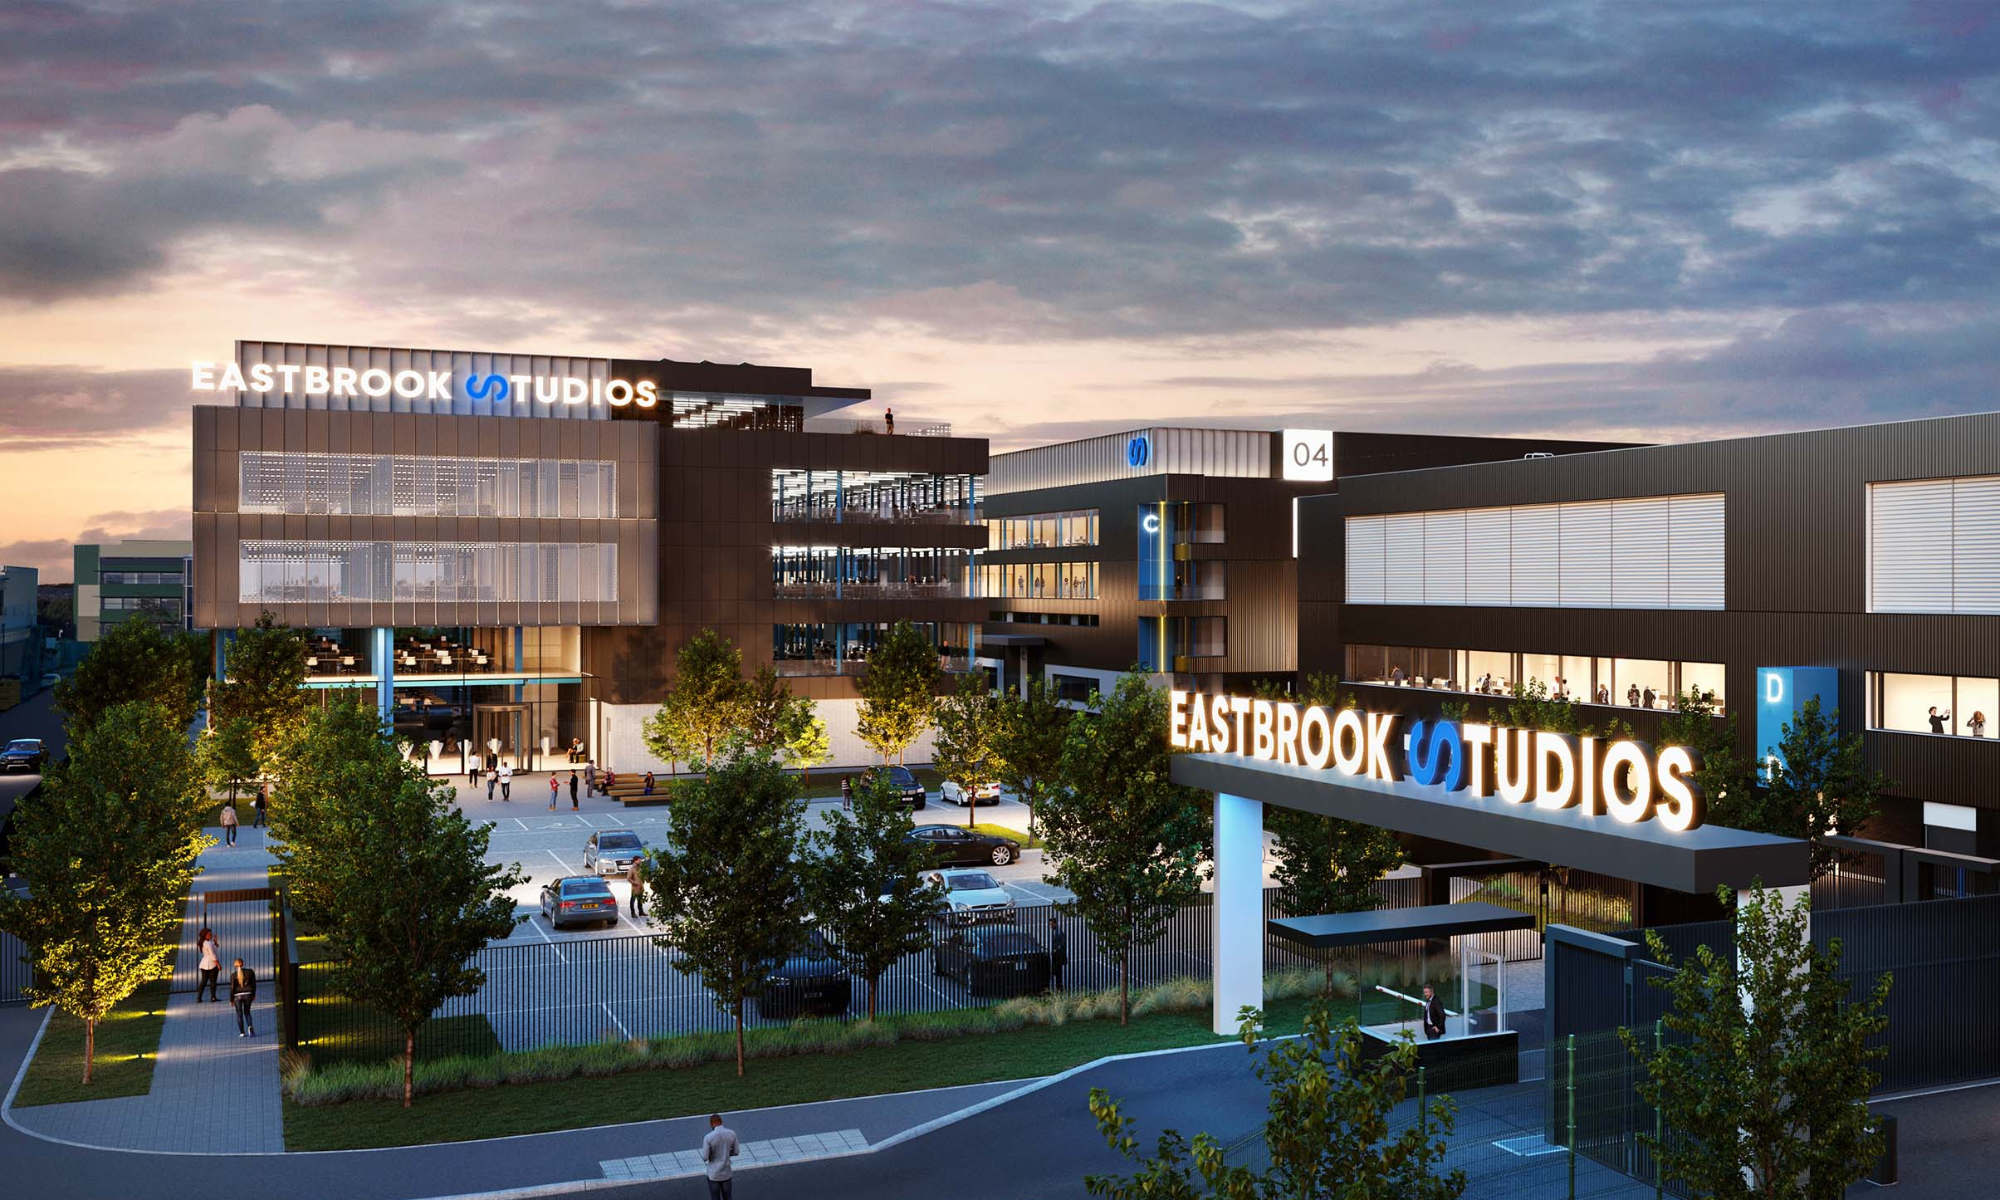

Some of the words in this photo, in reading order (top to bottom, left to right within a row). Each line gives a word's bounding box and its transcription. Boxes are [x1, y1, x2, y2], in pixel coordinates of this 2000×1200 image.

[192, 361, 452, 400] EASTBROOK
[465, 373, 657, 408] STUDIOS
[1293, 441, 1329, 467] 04
[1143, 514, 1160, 533] C
[1766, 673, 1784, 703] D
[1170, 690, 1397, 781] EASTBROOK
[1408, 718, 1706, 832] STUDIOS
